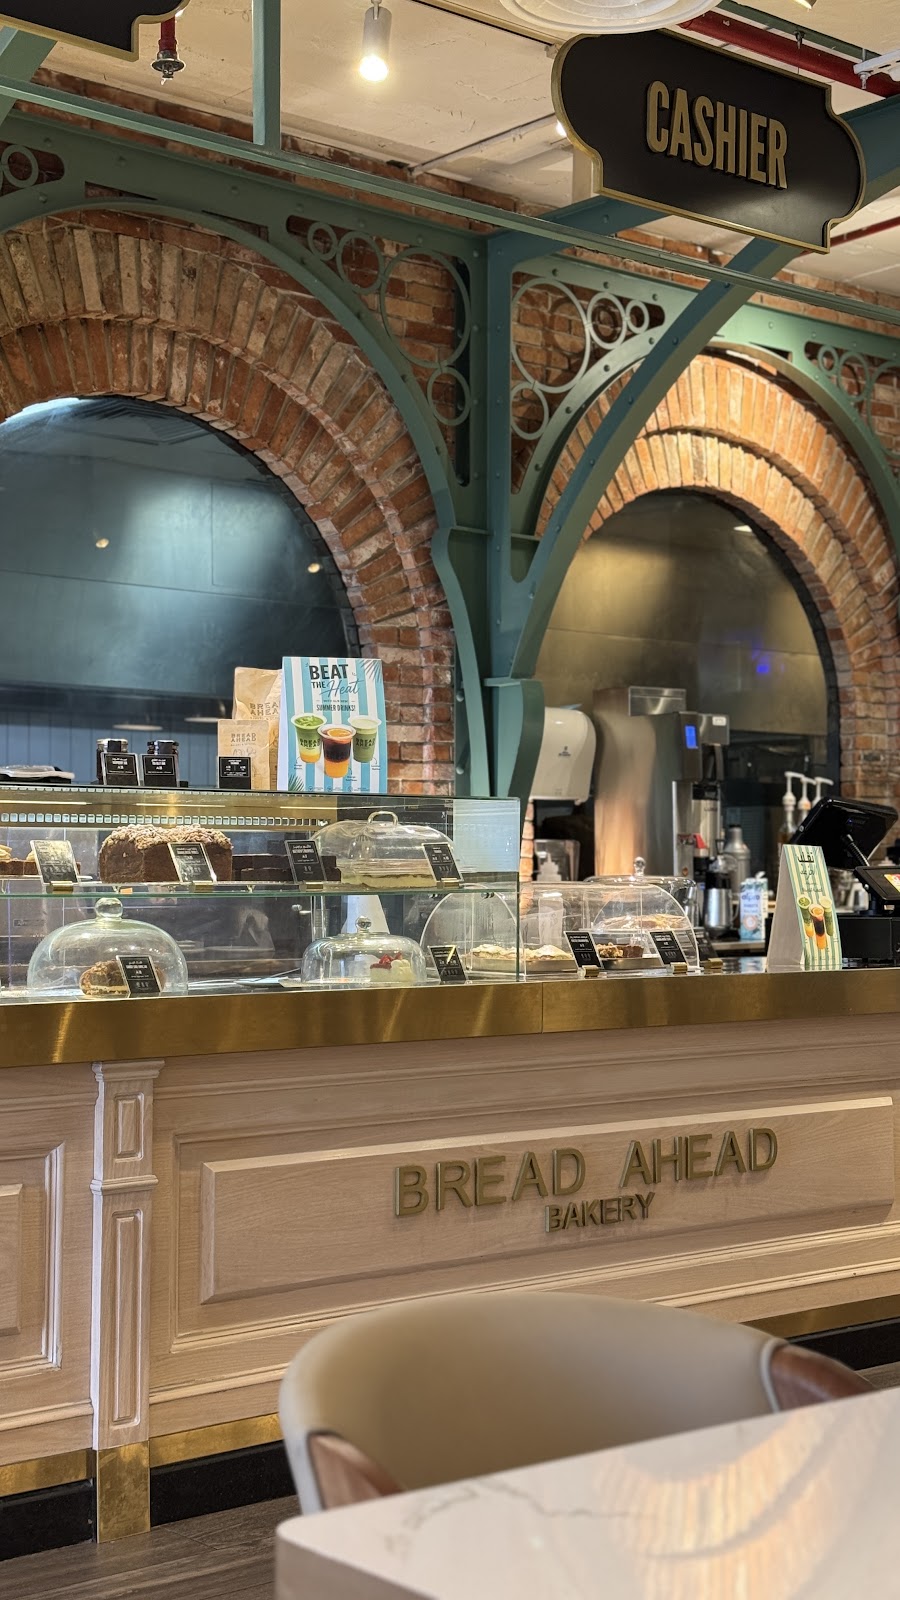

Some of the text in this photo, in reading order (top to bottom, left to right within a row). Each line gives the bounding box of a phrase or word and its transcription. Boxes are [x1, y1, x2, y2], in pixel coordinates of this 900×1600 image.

[646, 80, 788, 189] CASHIER
[309, 664, 348, 680] BEAT
[311, 678, 365, 698] THE Heat
[249, 702, 280, 710] BREA
[250, 708, 279, 716] AHEA
[316, 704, 337, 712] SUMMER
[394, 1128, 779, 1217] BREAD AHEAD
[545, 1191, 656, 1233] BAKERY
